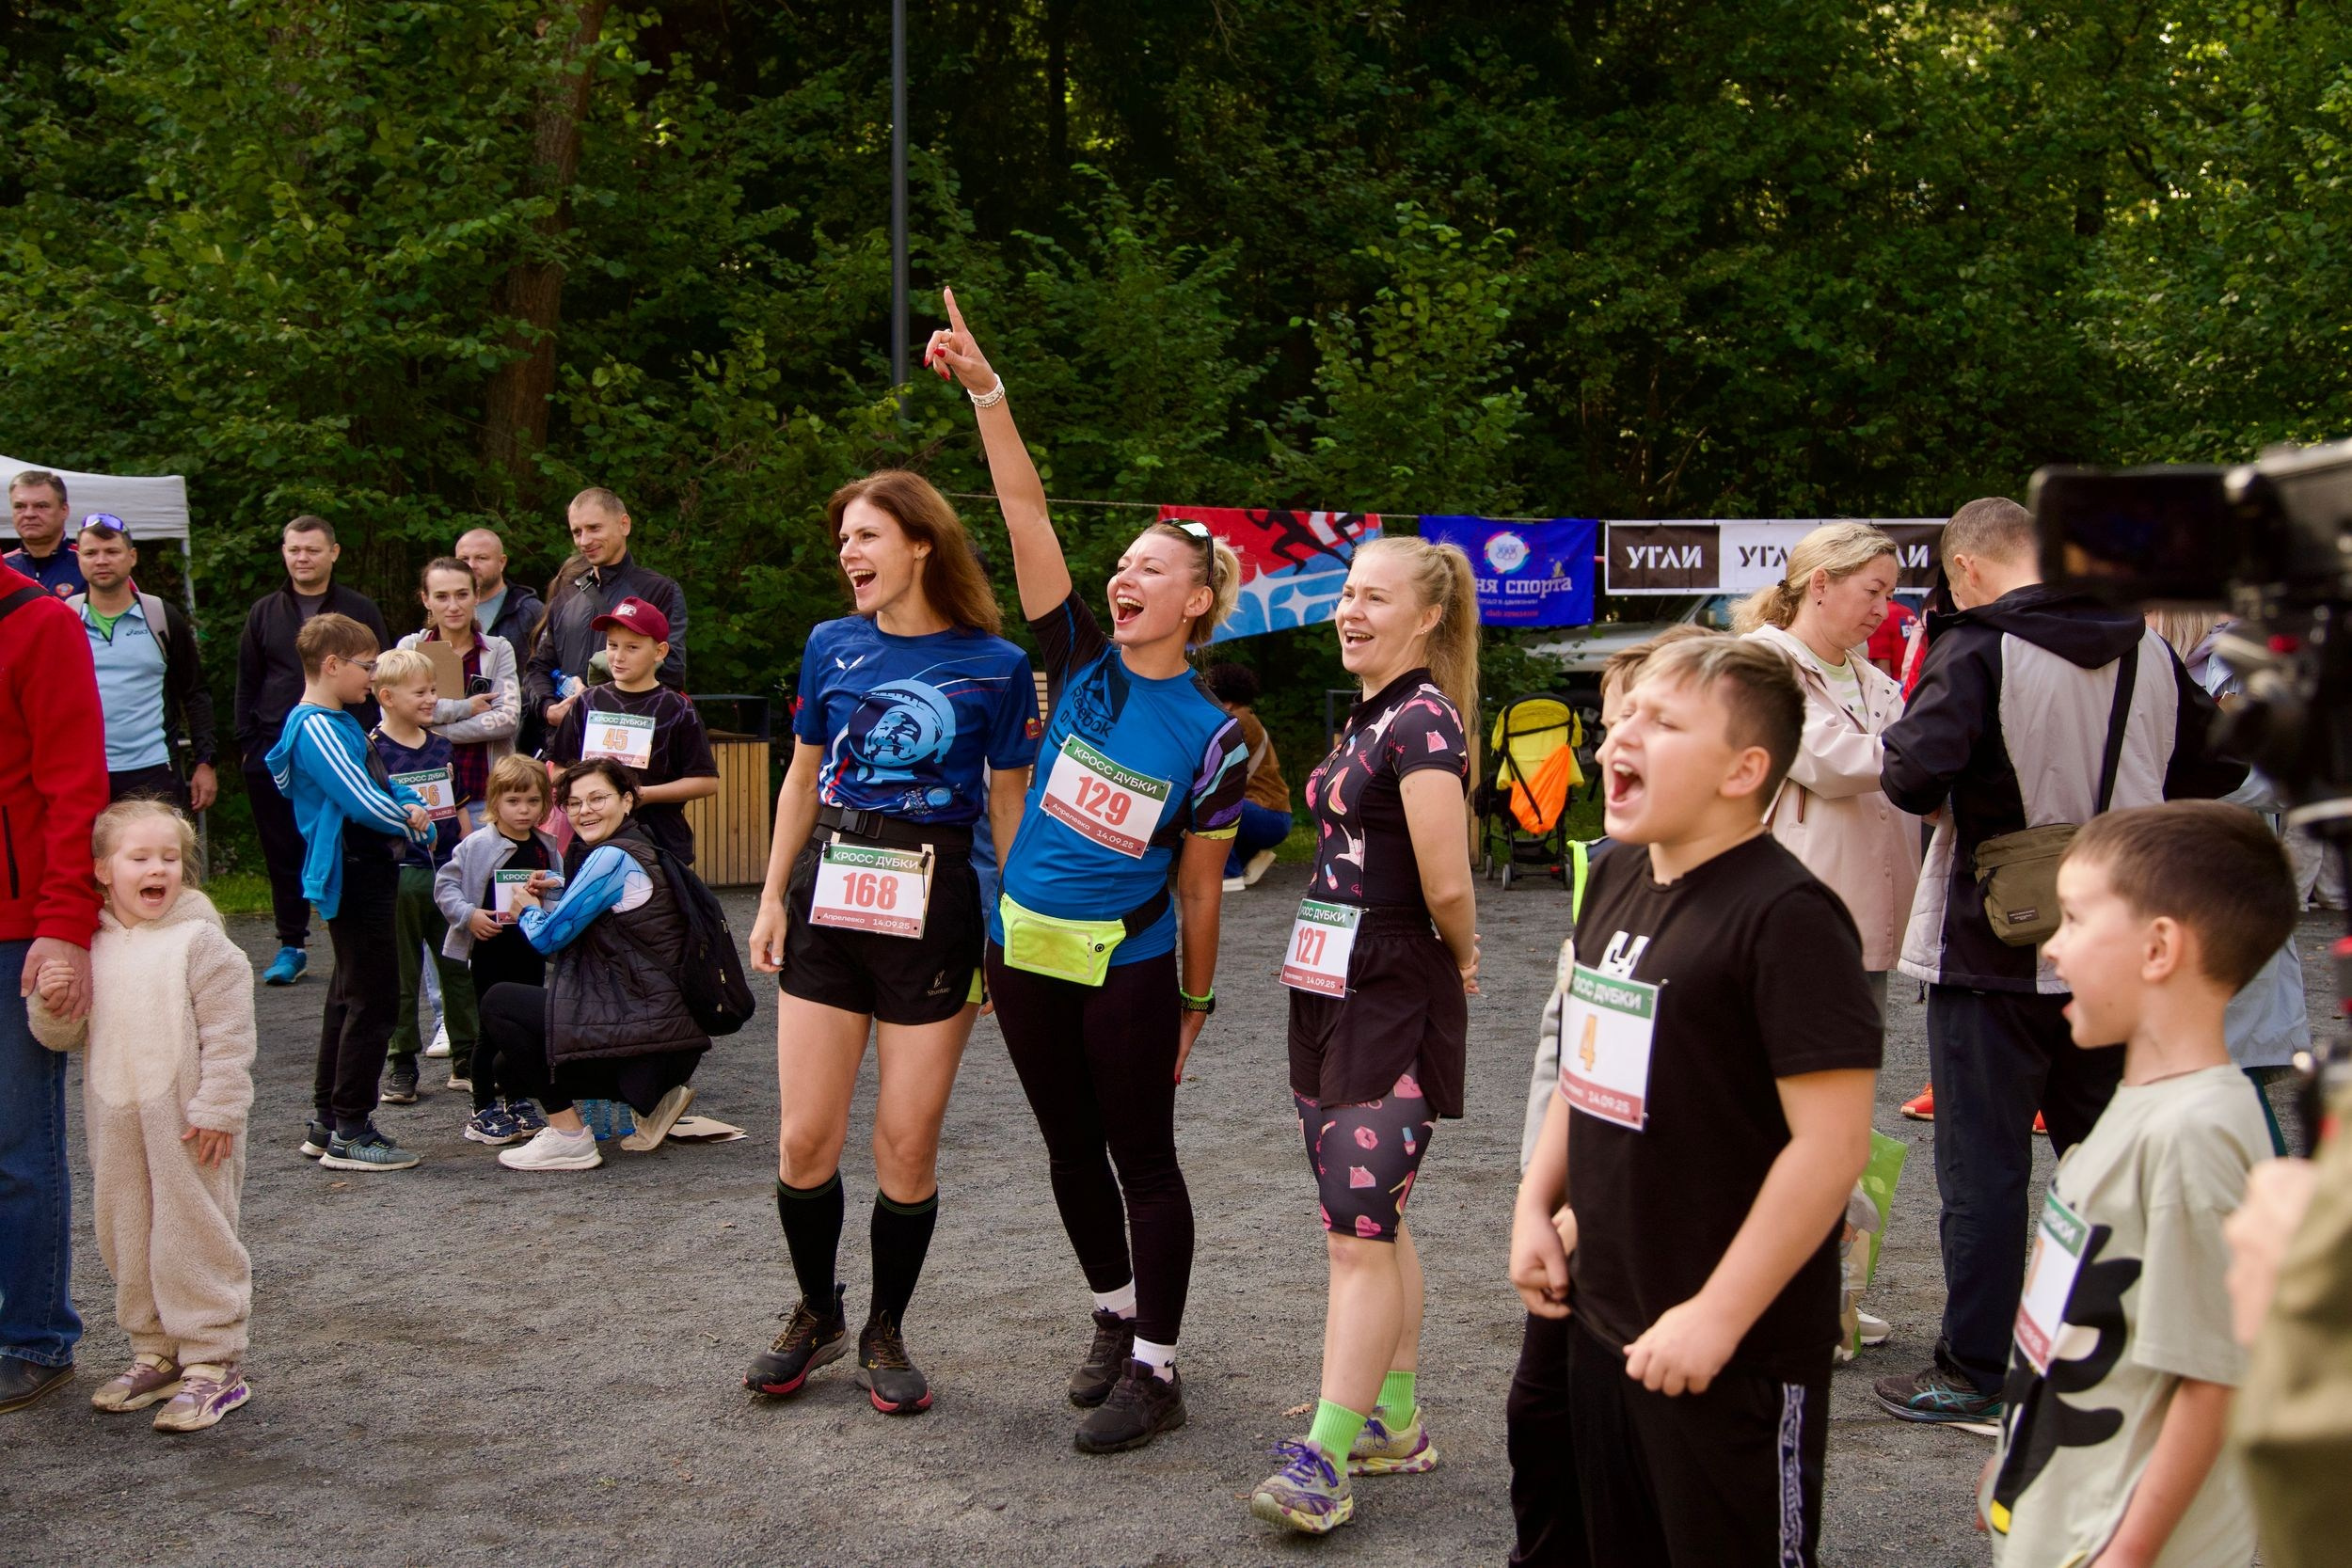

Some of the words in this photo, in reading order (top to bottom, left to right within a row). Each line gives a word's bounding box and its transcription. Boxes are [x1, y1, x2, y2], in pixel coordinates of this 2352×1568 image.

[1626, 546, 1703, 569] УГЛИ
[1738, 546, 1788, 567] УГЛ
[1505, 577, 1573, 598] спорта
[481, 679, 518, 731] addas
[1070, 684, 1114, 737] Reebok
[620, 718, 647, 727] ДУБКИ
[603, 728, 628, 751] 45
[398, 775, 426, 784] КРОСС
[1073, 746, 1114, 775] КРОСС
[1113, 770, 1158, 794] ДУБКИ
[1074, 776, 1132, 826] 129
[1052, 803, 1090, 831] Апрелевка
[1096, 830, 1135, 849] 14.09.25
[833, 851, 874, 863] КРОСС
[876, 856, 919, 870] ДУБКИ
[842, 872, 898, 911] 168
[822, 912, 866, 924] Апрелевка
[872, 918, 911, 929] 14.09.25
[1313, 909, 1345, 923] ДУБКИ
[1295, 927, 1327, 967] 127
[1306, 975, 1336, 989] 14.09.25
[1579, 1014, 1597, 1072] 4
